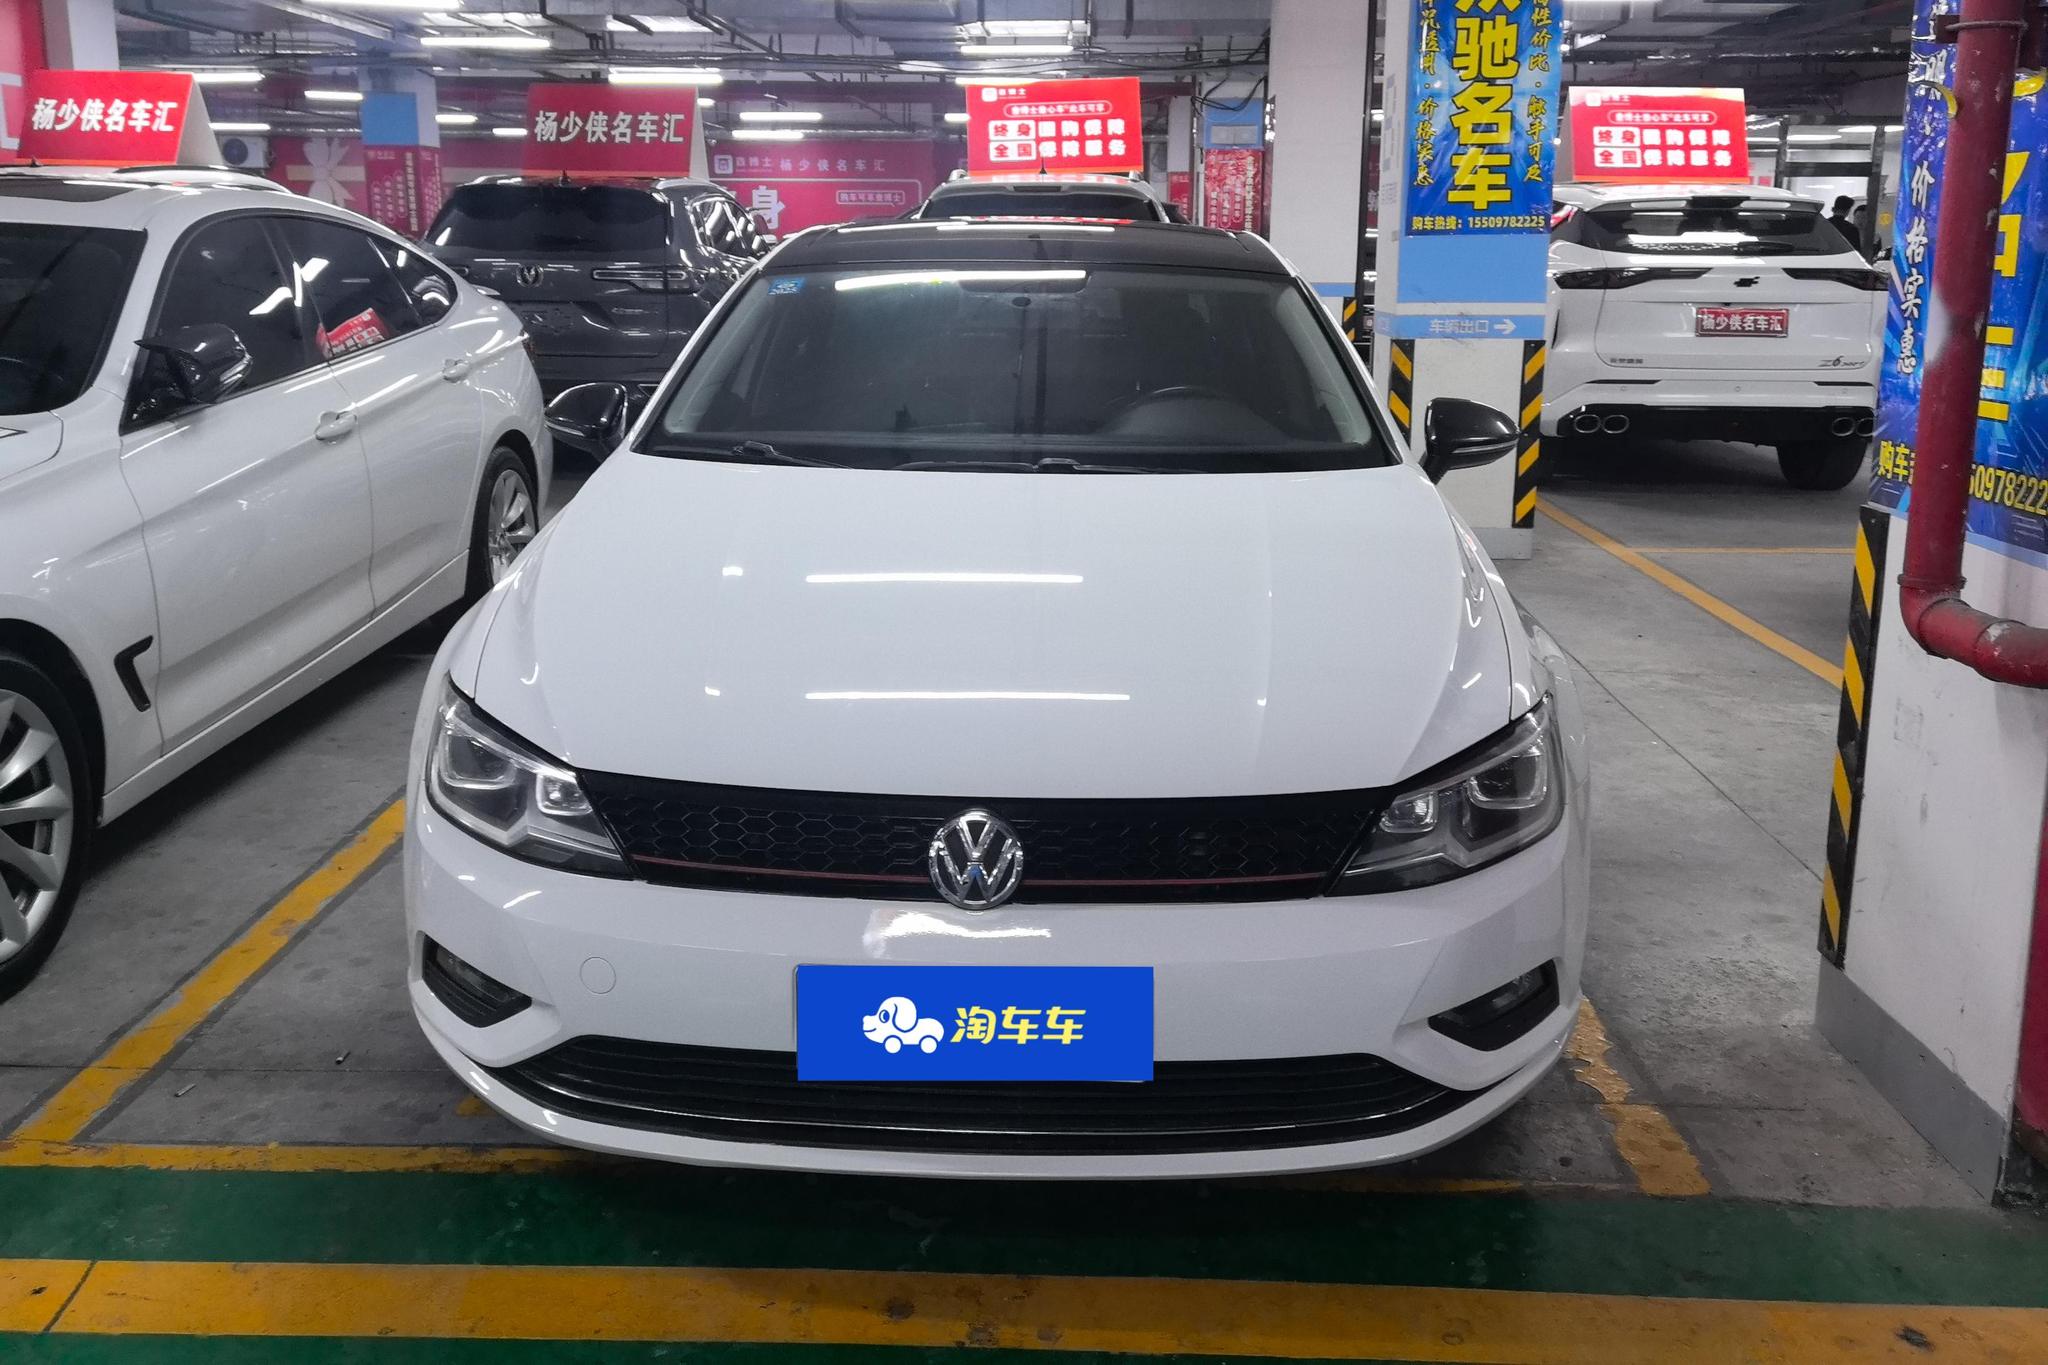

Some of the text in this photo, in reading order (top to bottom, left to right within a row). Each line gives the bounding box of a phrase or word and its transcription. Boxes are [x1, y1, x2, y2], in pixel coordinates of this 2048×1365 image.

[32, 97, 178, 132] 杨少侠名车汇
[1447, 0, 1521, 210] 驰名车
[534, 110, 685, 143] 杨少侠名车汇
[1896, 160, 1936, 374] 价格实惠
[1429, 318, 1489, 334] 车辆出口
[1702, 314, 1783, 331] 杨少侠名车汇
[1878, 440, 2048, 516] 购车 0978222
